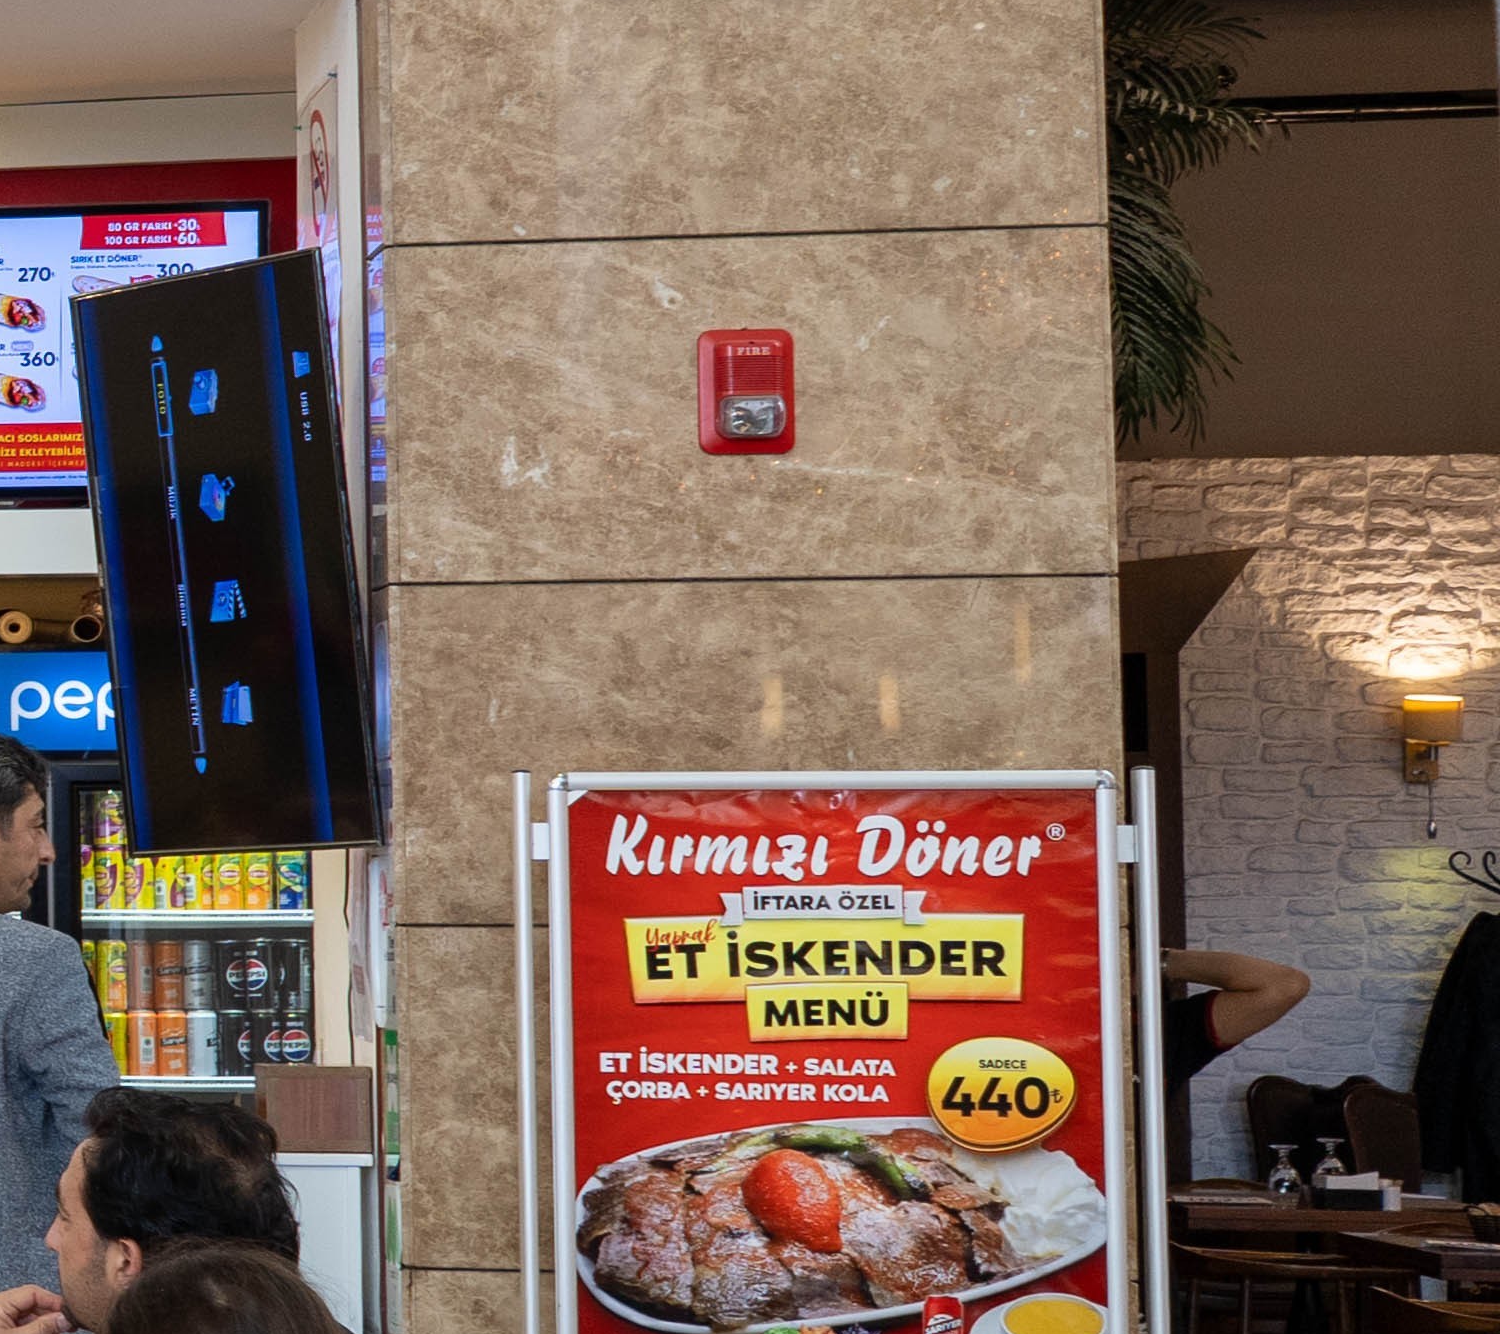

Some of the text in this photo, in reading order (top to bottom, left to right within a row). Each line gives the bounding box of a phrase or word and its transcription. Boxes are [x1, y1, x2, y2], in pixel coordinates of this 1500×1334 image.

[736, 346, 771, 355] FIRE
[606, 814, 1041, 881] Kırmızı Döner
[753, 888, 895, 912] İFTARA ÖZEL
[646, 931, 1006, 981] ET İSKENDER
[763, 992, 889, 1027] MENÜ
[599, 1046, 896, 1077] ET İSKENDER SALATA
[978, 1058, 1028, 1070] SADECE
[606, 1080, 889, 1106] ÇORBA SARIYER KOLA
